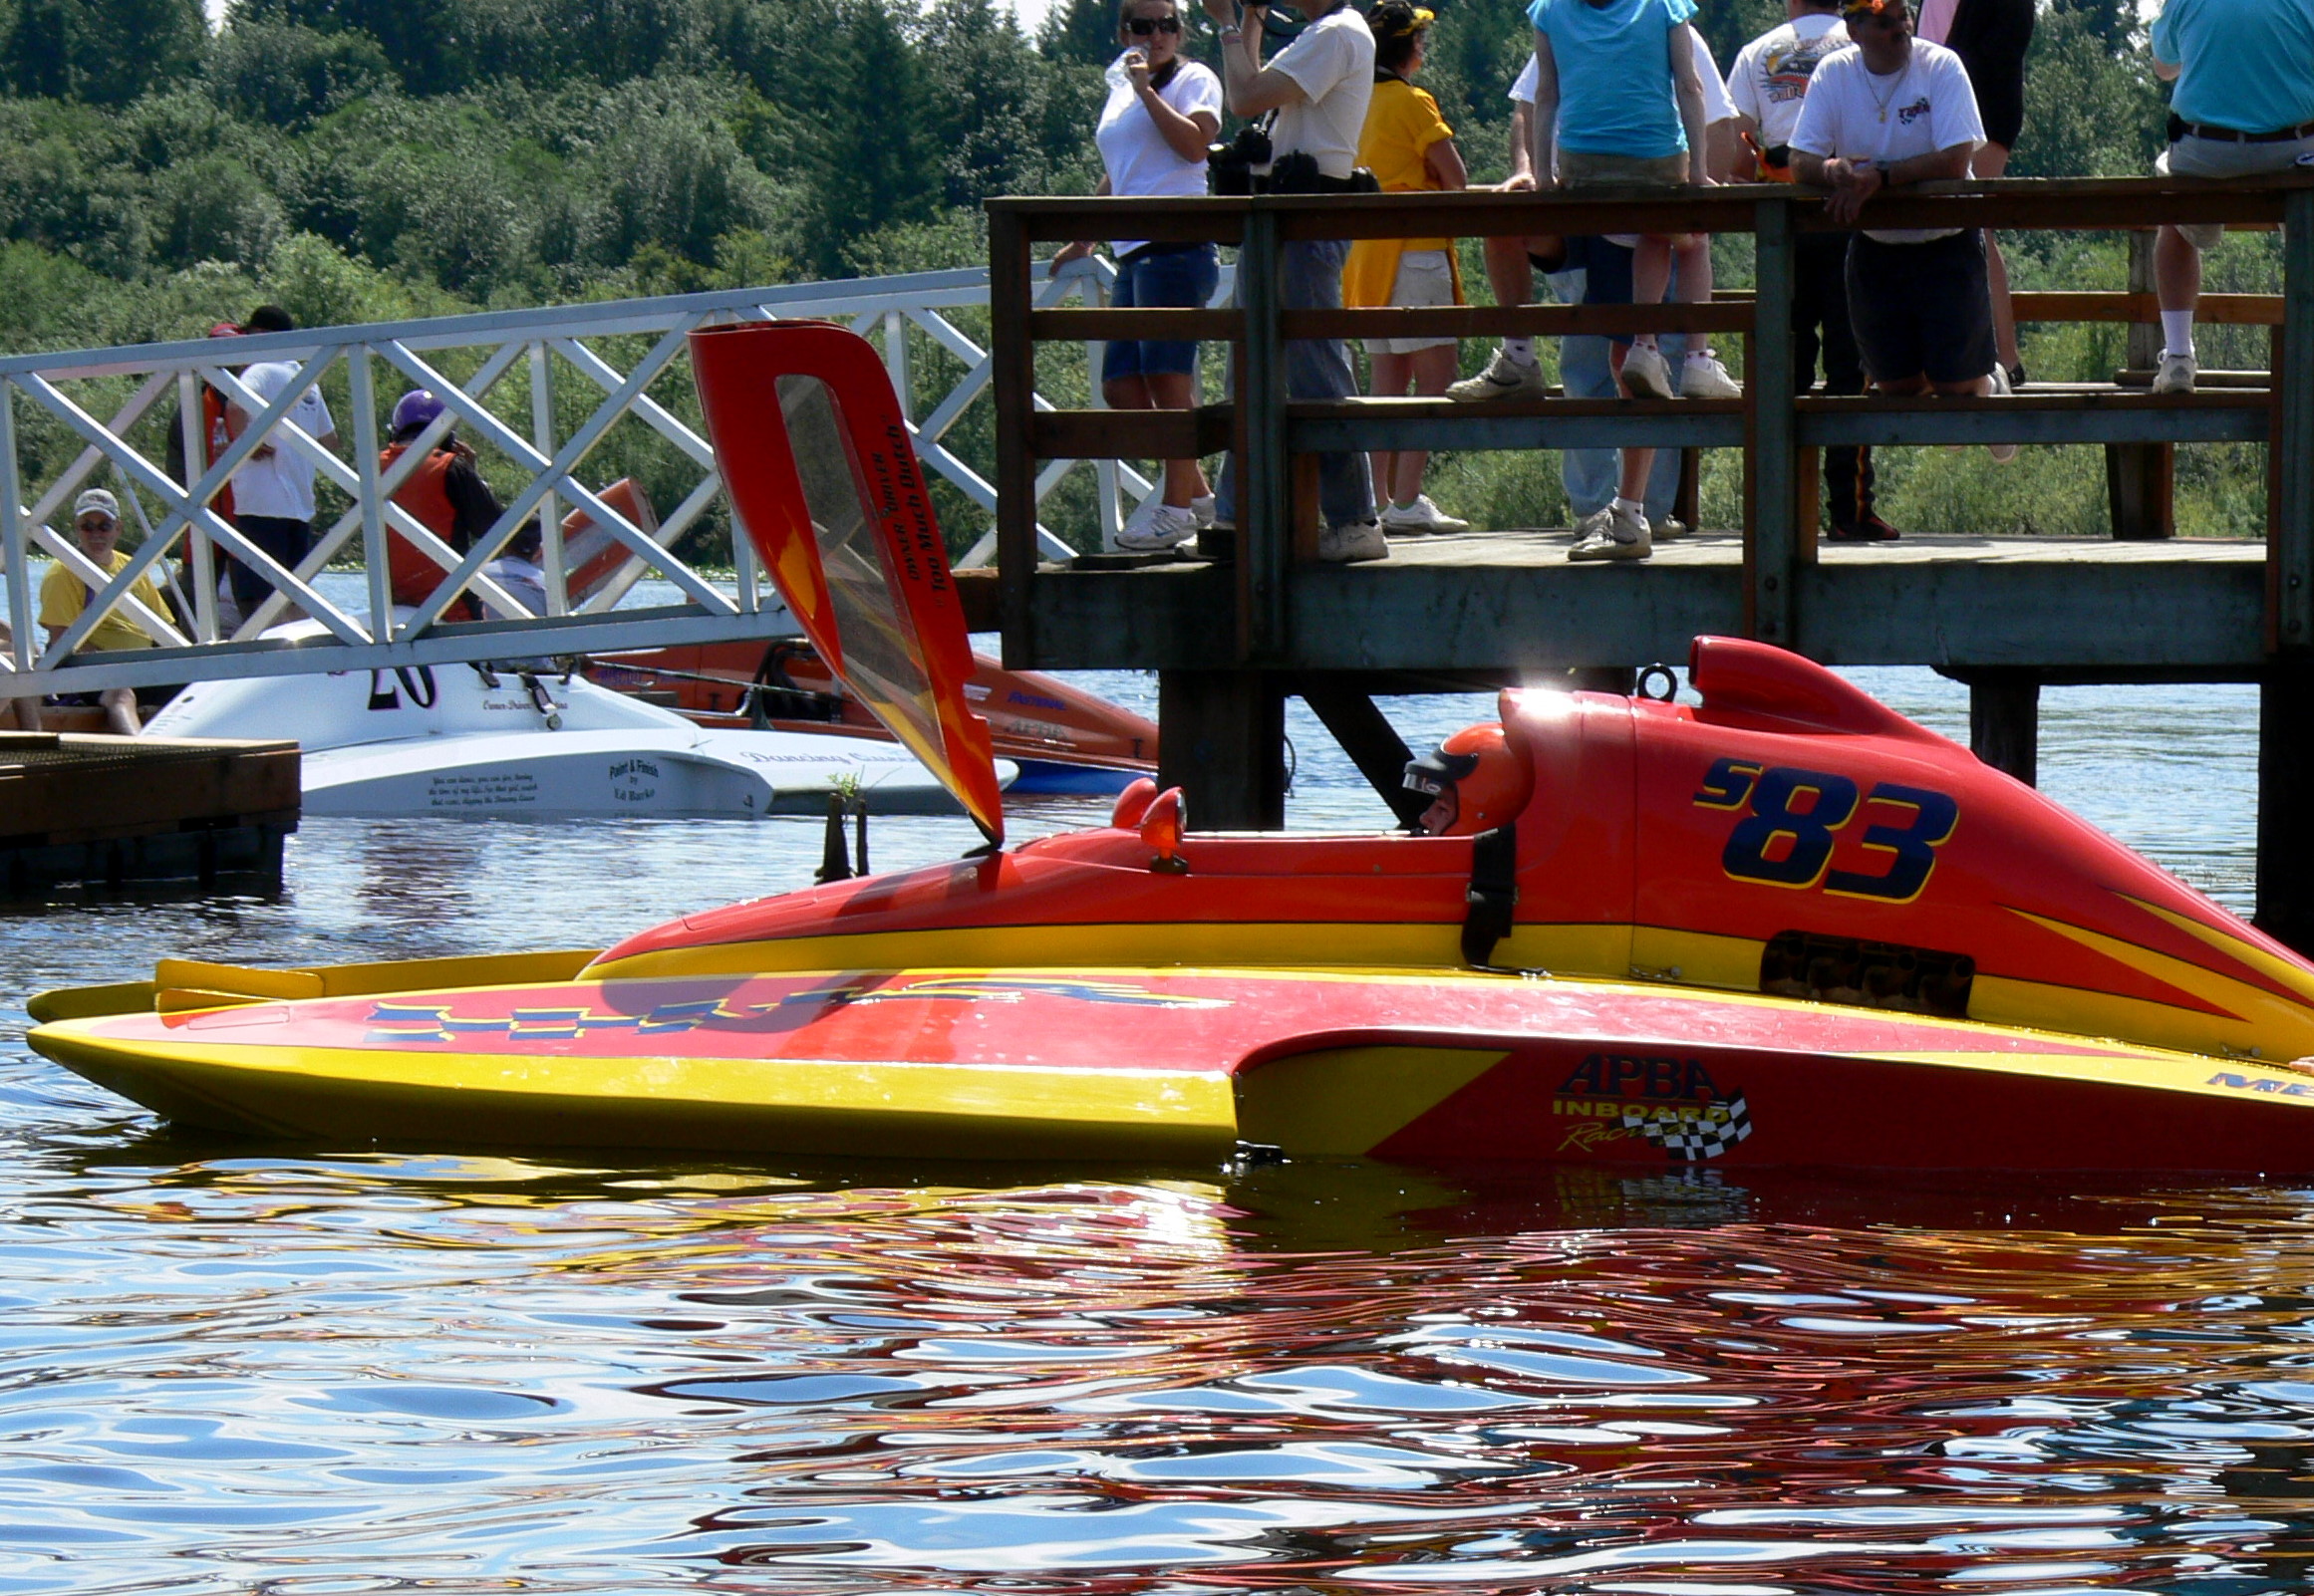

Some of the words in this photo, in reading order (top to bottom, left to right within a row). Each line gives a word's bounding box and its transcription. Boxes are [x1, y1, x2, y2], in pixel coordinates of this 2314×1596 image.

[908, 494, 934, 552] Much
[1555, 1053, 1728, 1103] APBA
[1553, 1100, 1730, 1124] INBOARD
